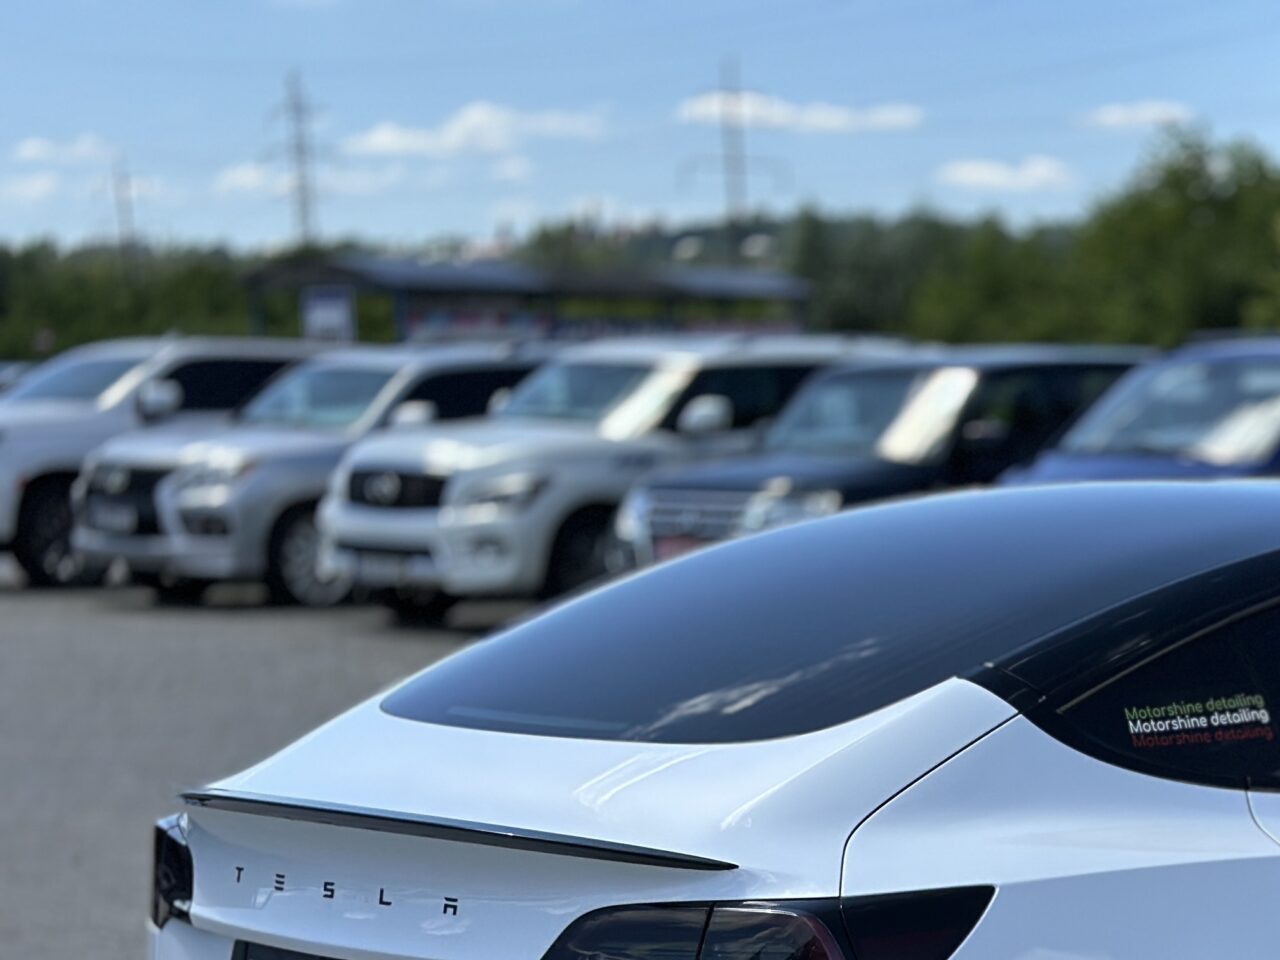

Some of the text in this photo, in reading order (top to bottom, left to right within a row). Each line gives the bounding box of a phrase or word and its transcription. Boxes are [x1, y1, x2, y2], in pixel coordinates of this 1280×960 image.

[1125, 693, 1265, 720] Motorshine detailing
[1128, 708, 1270, 734] Motorshine detailing
[1132, 724, 1274, 748] Motorshine detailing
[235, 866, 459, 916] TESLA
